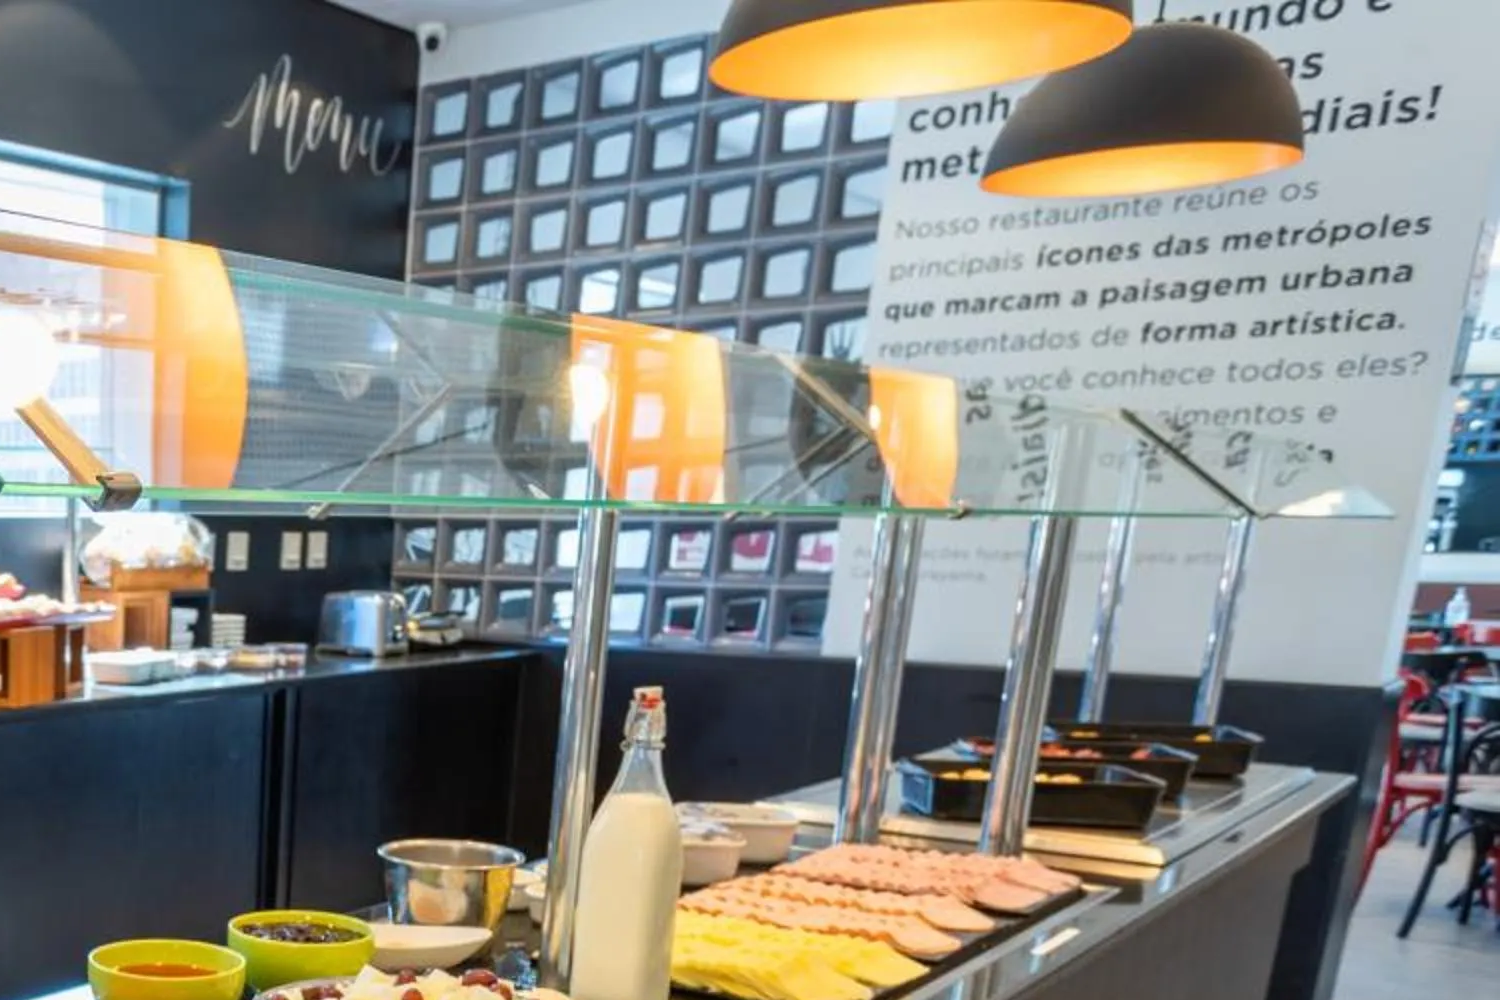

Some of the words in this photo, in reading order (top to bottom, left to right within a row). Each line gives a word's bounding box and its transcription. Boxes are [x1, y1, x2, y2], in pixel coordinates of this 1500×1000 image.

[222, 53, 402, 176] Menu
[901, 145, 981, 183] met
[1302, 85, 1442, 134] diais!
[908, 90, 1011, 133] conh
[894, 216, 980, 240] Nosso
[988, 197, 1164, 232] restaurante
[1279, 180, 1320, 203] os
[888, 250, 1025, 283] principais
[1036, 240, 1142, 269] ícones
[1152, 234, 1210, 259] das
[1221, 213, 1433, 253] metrópoles
[884, 299, 935, 324] que
[943, 290, 1061, 317] marcam
[1070, 288, 1088, 307] a
[1098, 273, 1267, 312] paisagem
[1280, 262, 1415, 293] urbana
[877, 327, 1081, 361] representados
[1090, 325, 1130, 348] de
[1140, 320, 1237, 345] forma
[1249, 308, 1406, 339] artística.
[1003, 365, 1073, 392] você
[1081, 362, 1216, 391] conhece
[1226, 358, 1324, 384] todos
[1336, 350, 1430, 379] eles?
[1317, 404, 1339, 424] e
